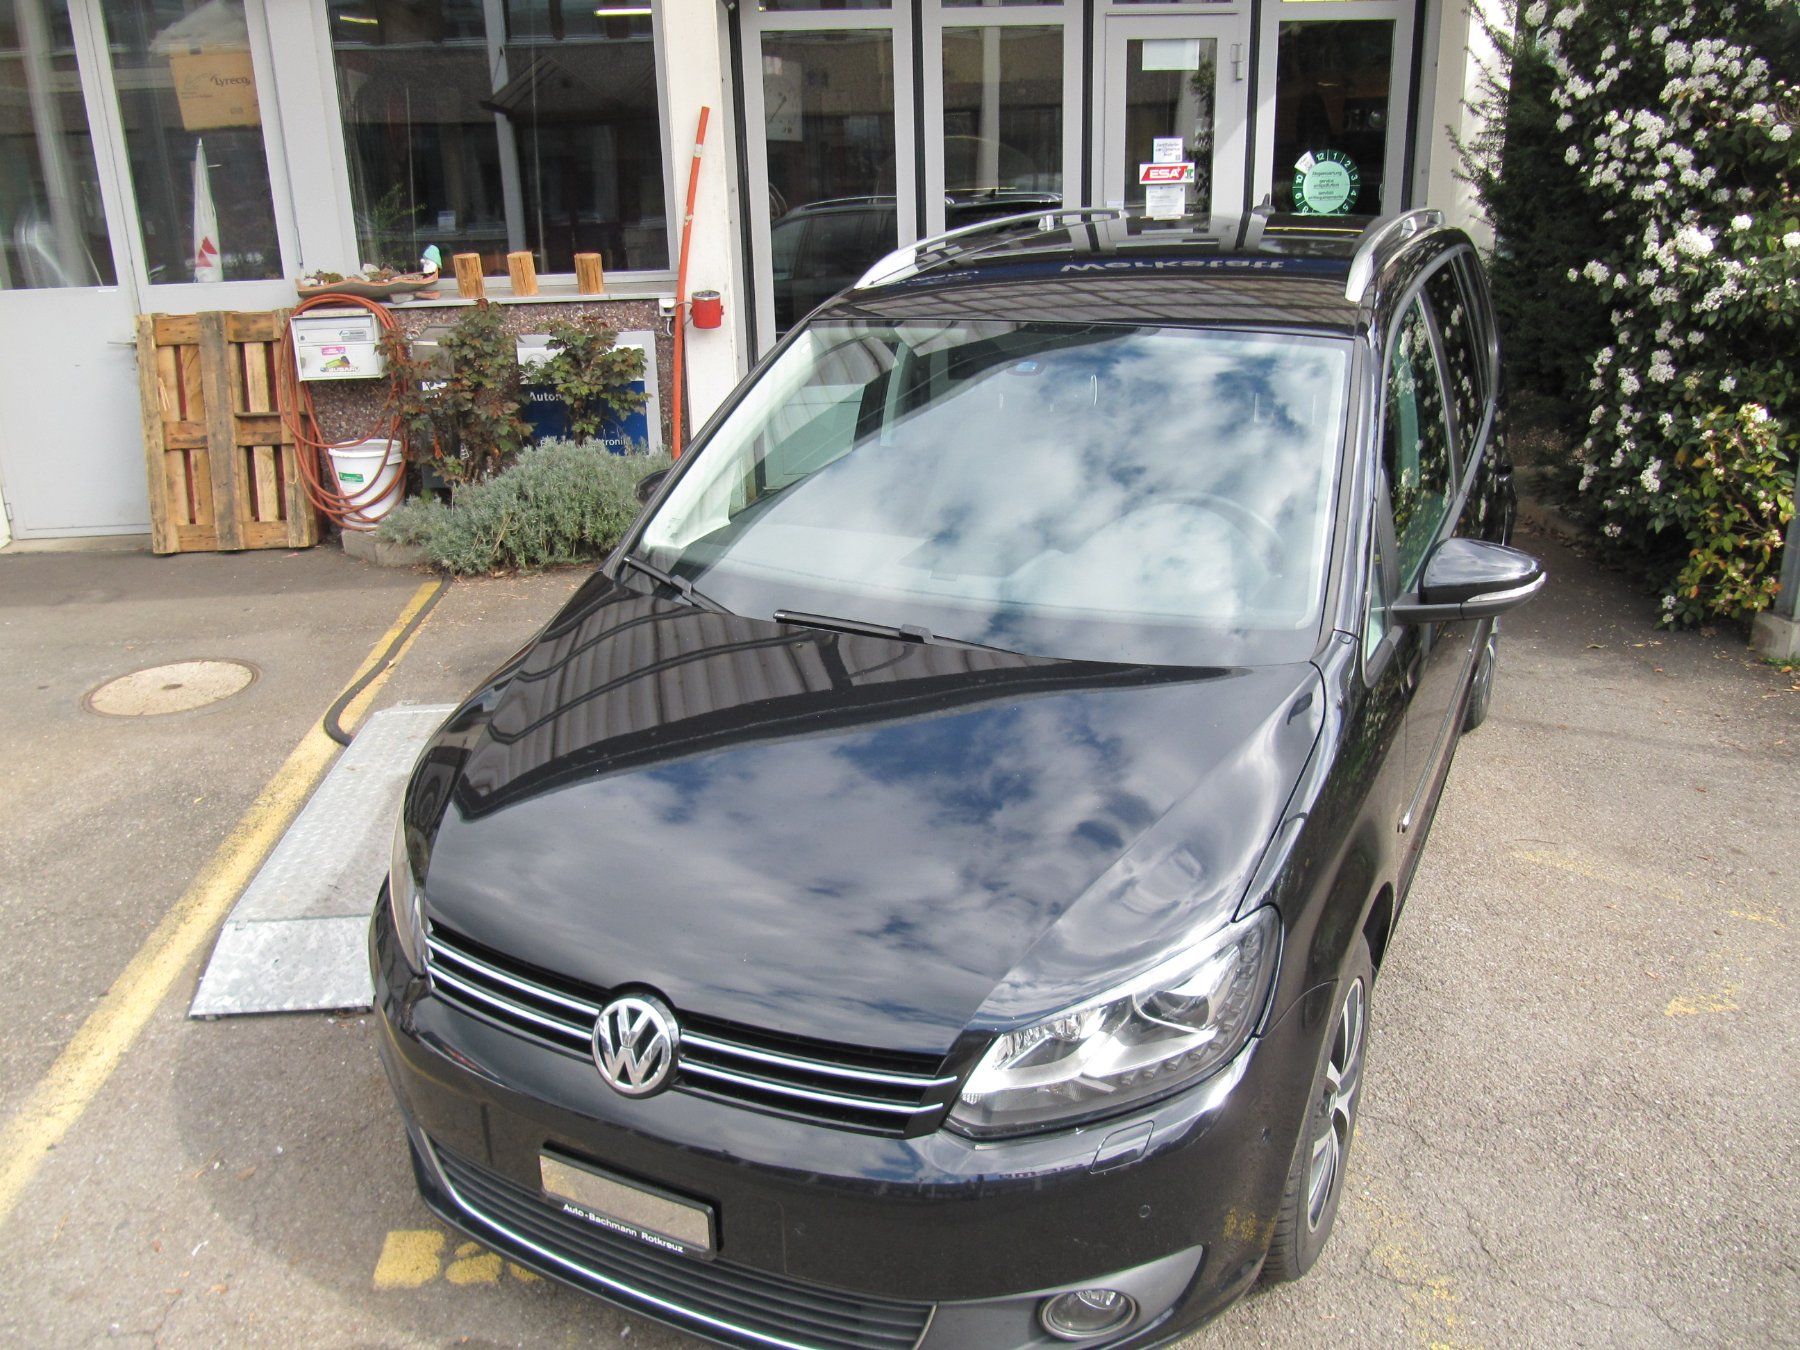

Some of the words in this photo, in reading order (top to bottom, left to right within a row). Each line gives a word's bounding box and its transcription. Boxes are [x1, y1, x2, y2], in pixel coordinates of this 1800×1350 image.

[1316, 152, 1325, 161] 12
[1333, 152, 1338, 160] 1
[1344, 160, 1351, 168] 2
[1295, 174, 1304, 185] 10
[1294, 192, 1303, 200] 9
[1342, 203, 1349, 211] 5
[641, 1231, 684, 1253] Rotkreuz
